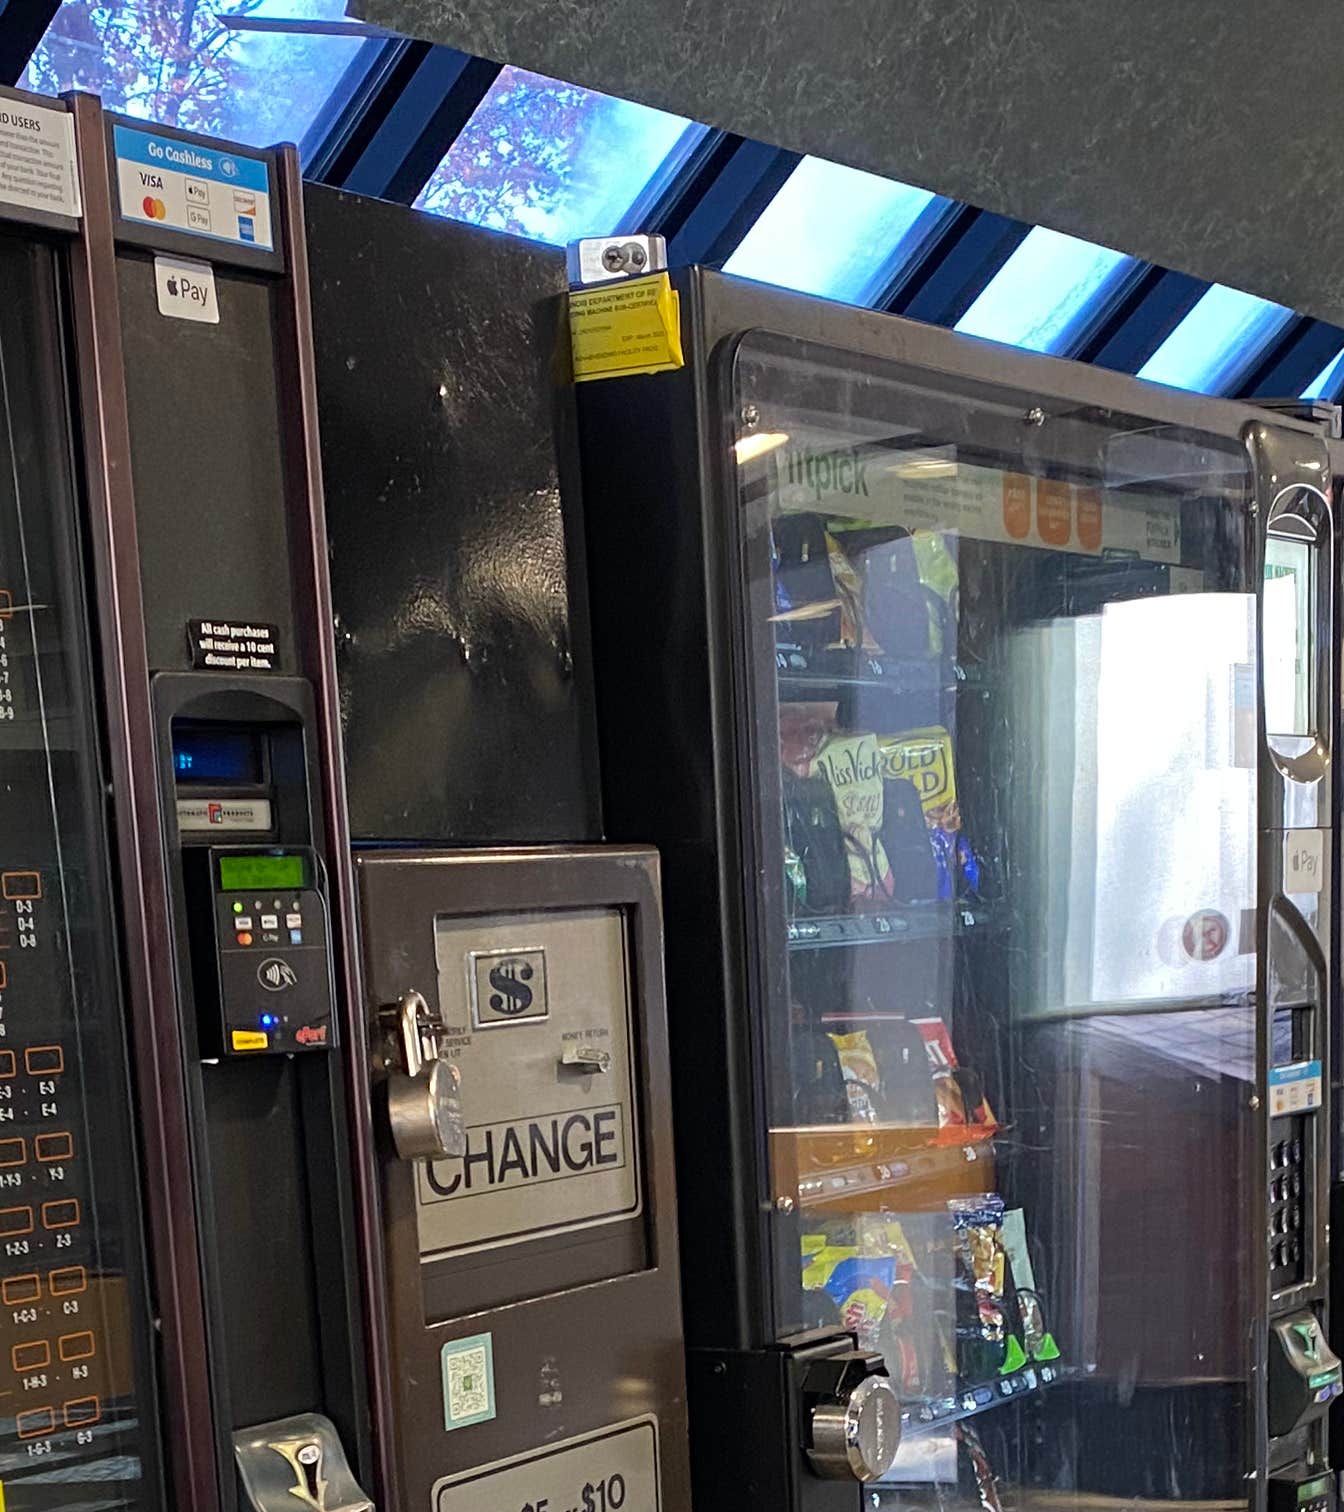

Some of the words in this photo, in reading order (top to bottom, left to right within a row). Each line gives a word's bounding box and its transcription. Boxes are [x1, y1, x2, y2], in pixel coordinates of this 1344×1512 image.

[11, 113, 41, 132] USERS
[148, 142, 163, 159] Go
[165, 145, 213, 171] Cashless
[139, 172, 163, 190] VISA
[180, 278, 208, 306] Pay
[213, 624, 230, 636] cash
[230, 625, 269, 639] purchases
[246, 641, 256, 653] 10
[257, 643, 275, 654] cent
[236, 656, 250, 669] per
[489, 957, 534, 1015] $
